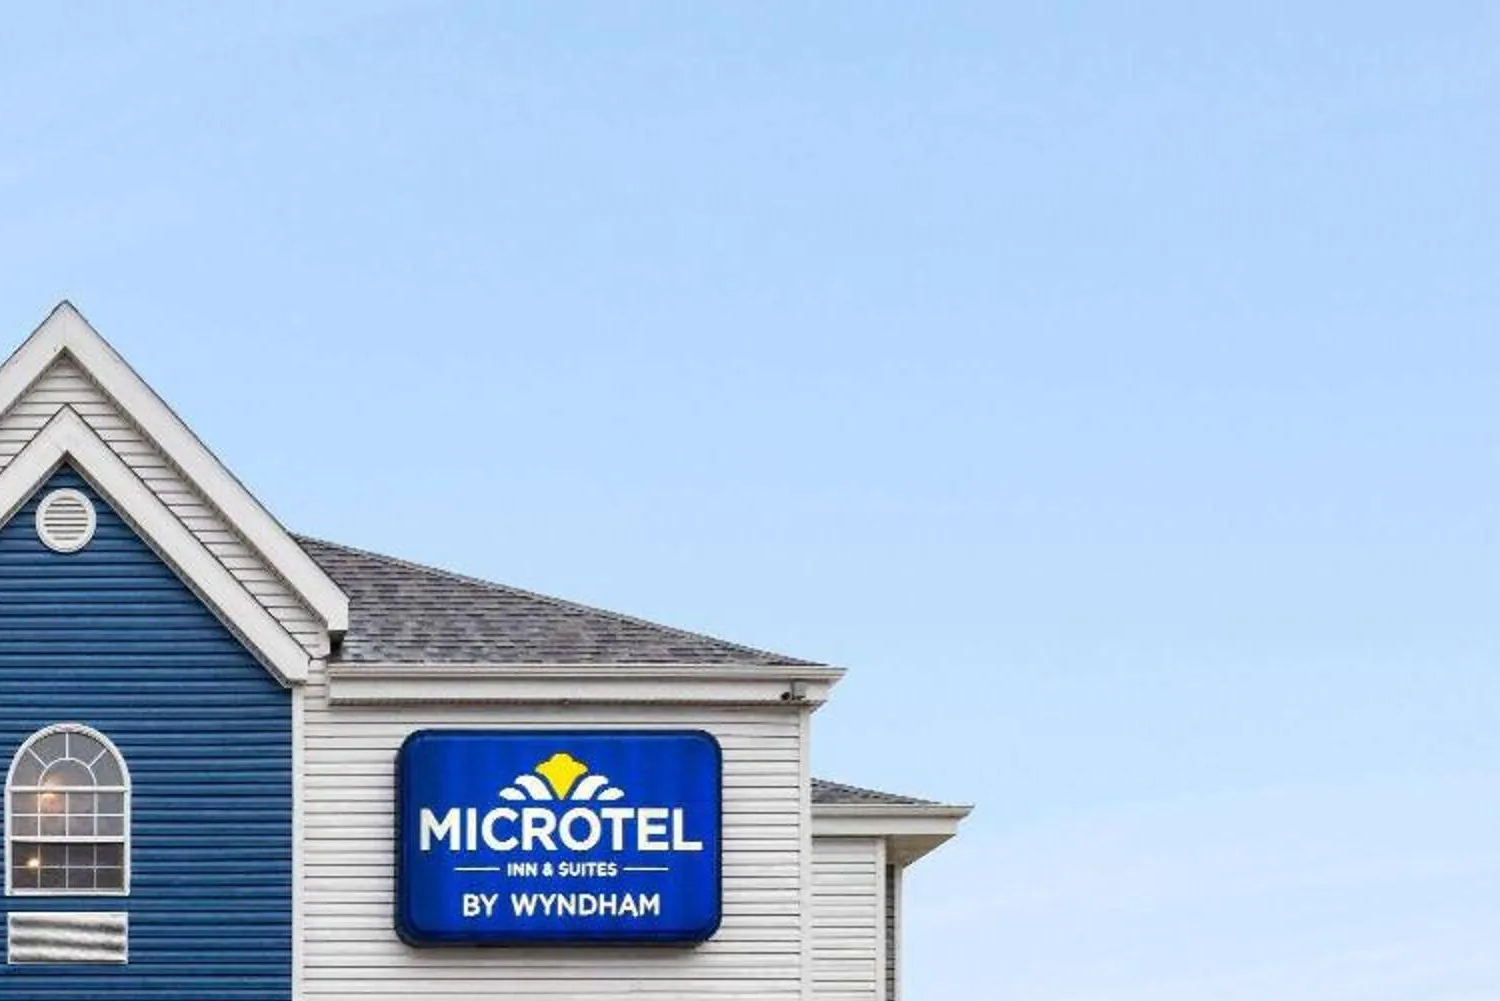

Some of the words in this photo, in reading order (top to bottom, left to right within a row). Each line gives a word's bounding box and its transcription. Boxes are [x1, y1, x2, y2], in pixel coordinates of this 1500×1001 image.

[418, 807, 703, 851] MICROTEL
[507, 862, 537, 877] INN
[543, 862, 552, 877] &
[558, 861, 618, 877] SUITES
[462, 893, 498, 917] BY
[511, 893, 661, 918] WYNDHAM
